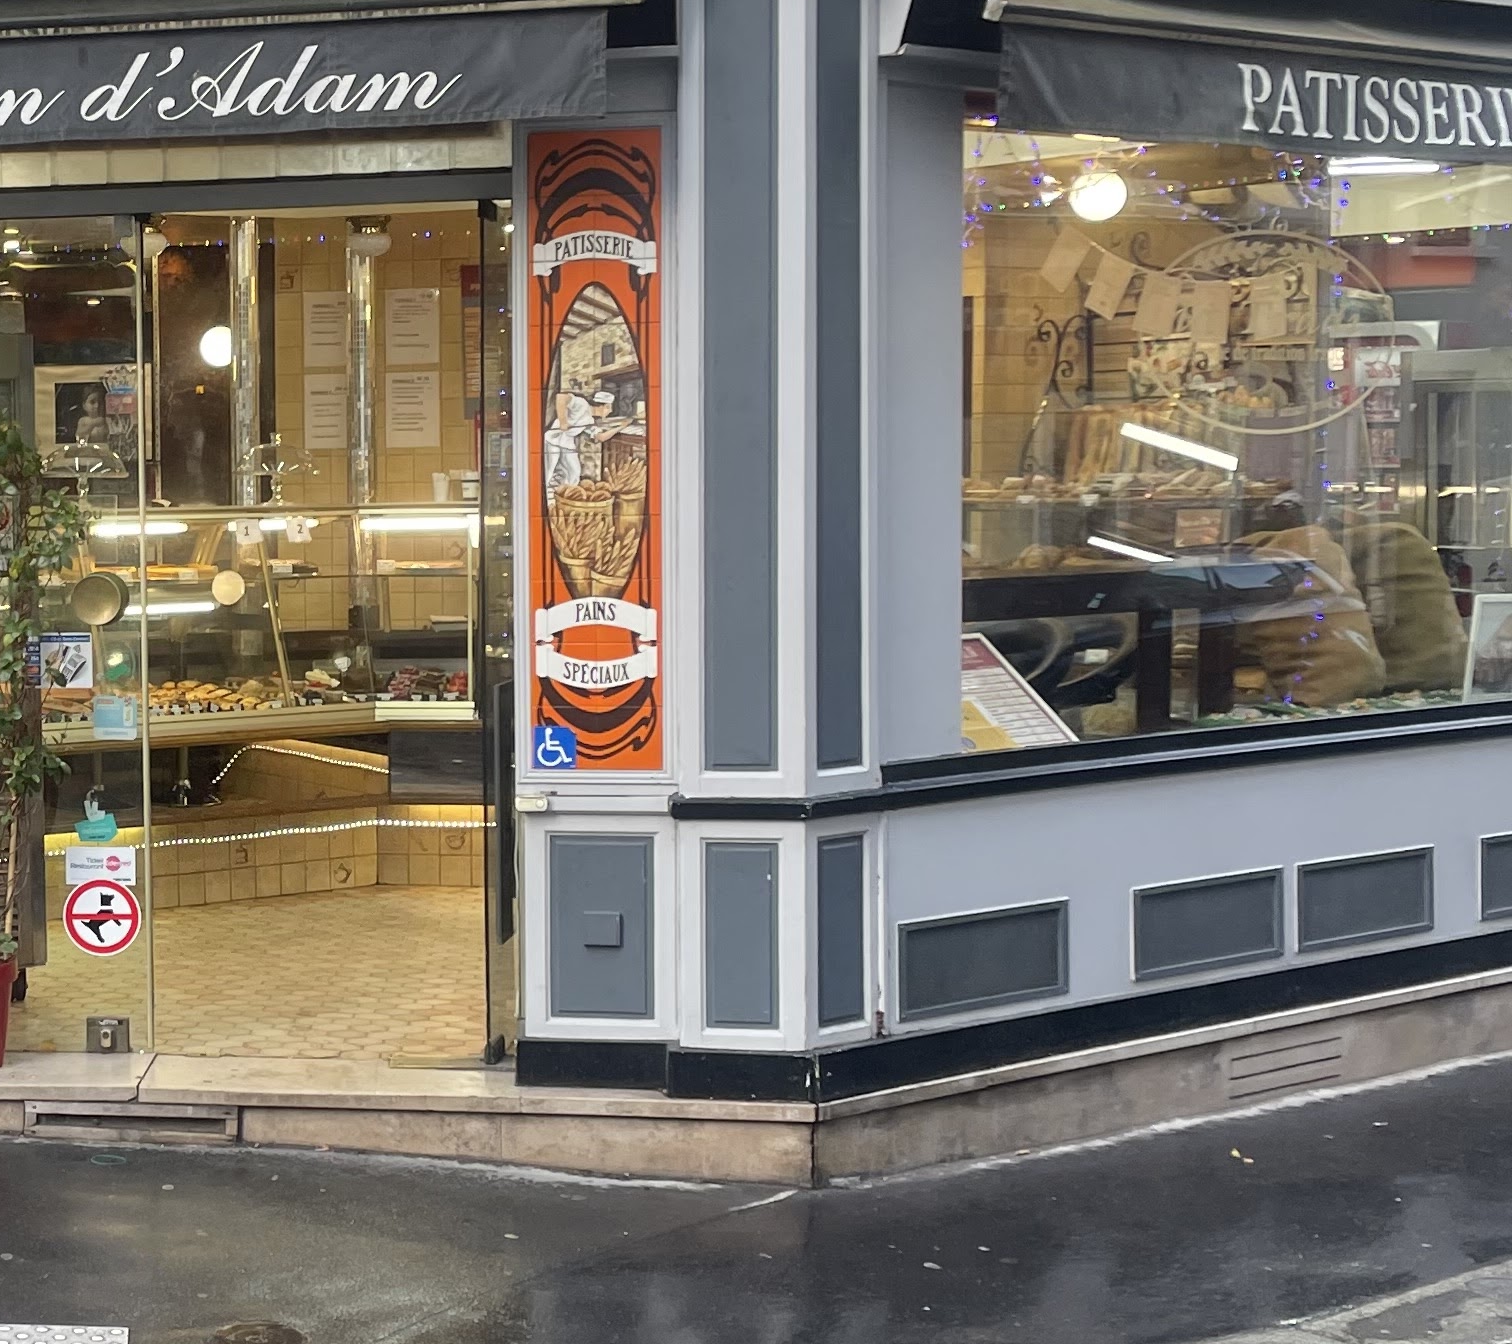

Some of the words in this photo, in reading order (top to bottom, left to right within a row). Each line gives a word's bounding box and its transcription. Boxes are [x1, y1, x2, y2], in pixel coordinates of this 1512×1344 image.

[79, 41, 463, 122] d'Adam
[1238, 62, 1512, 148] PATISSERI
[554, 234, 634, 262] PATISSERIE
[297, 523, 304, 534] 2
[575, 601, 617, 623] PAINS
